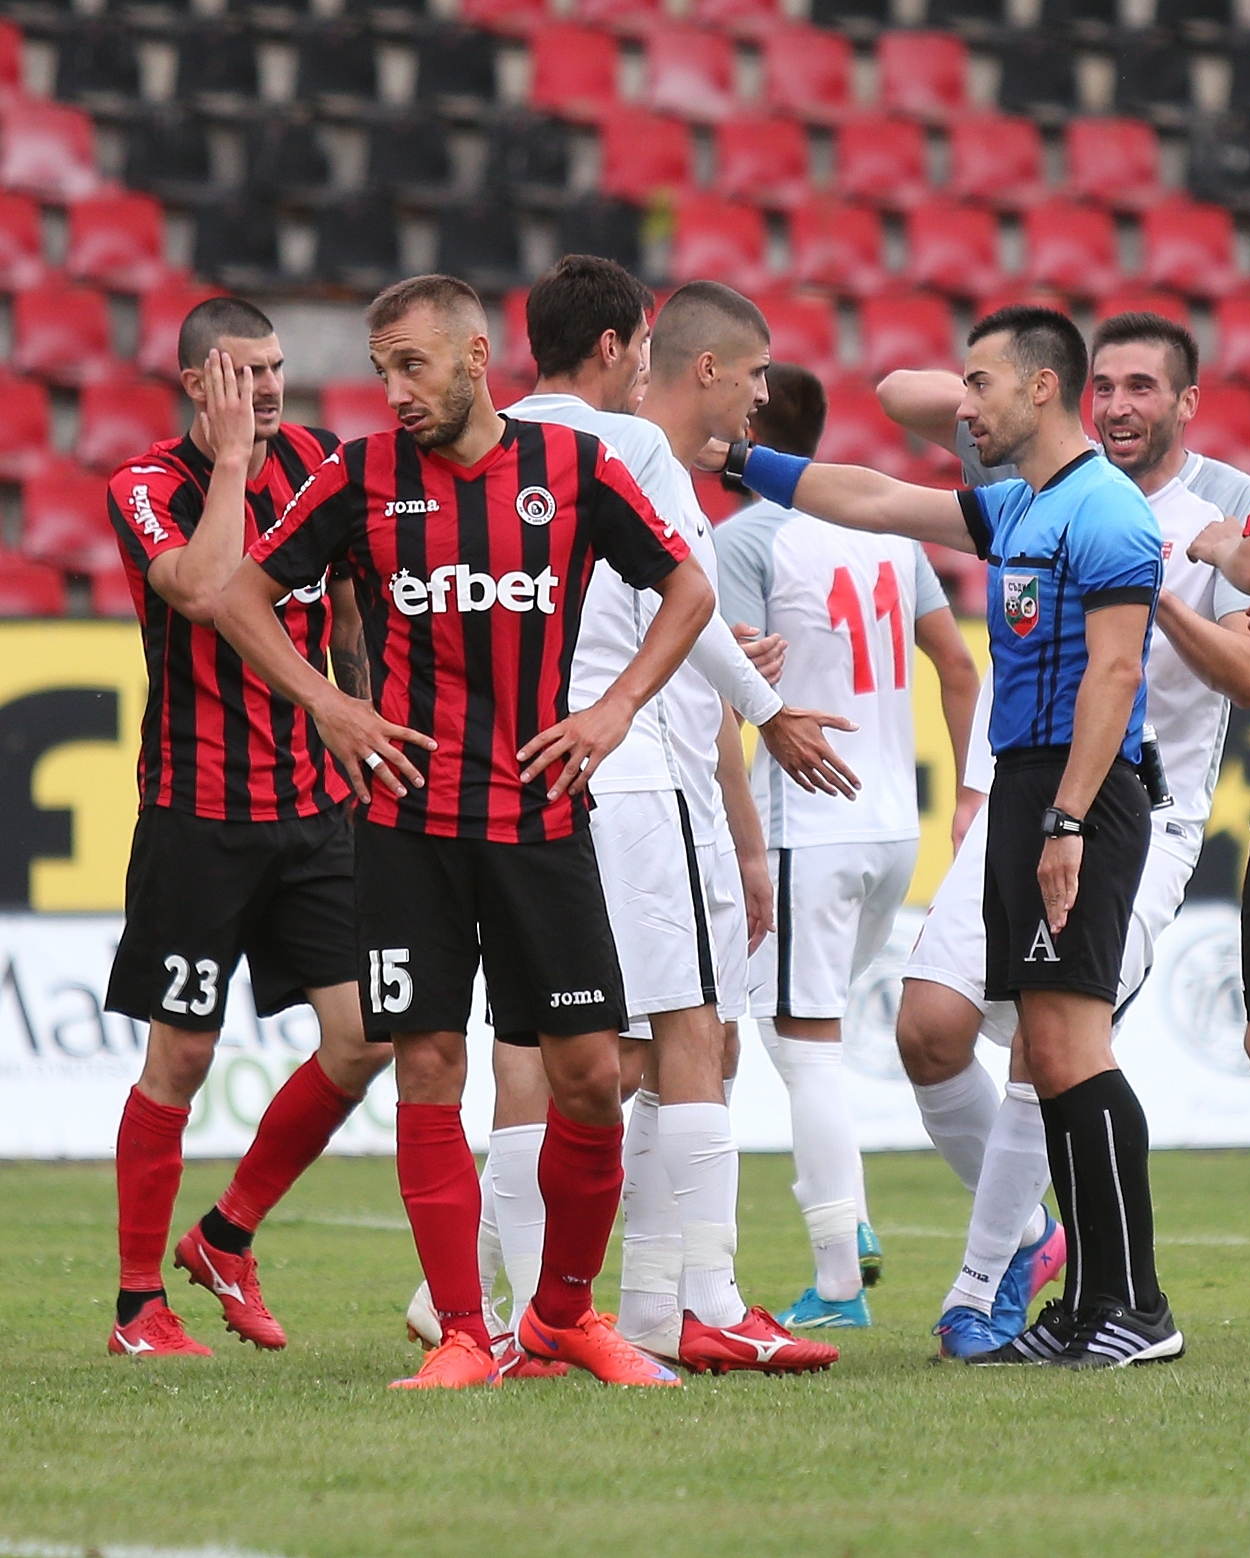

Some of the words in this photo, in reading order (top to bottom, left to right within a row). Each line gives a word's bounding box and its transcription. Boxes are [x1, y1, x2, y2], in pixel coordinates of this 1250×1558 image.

[391, 563, 559, 617] efbet
[826, 560, 907, 697] 11
[161, 954, 221, 1016] 23
[368, 948, 413, 1014] 15
